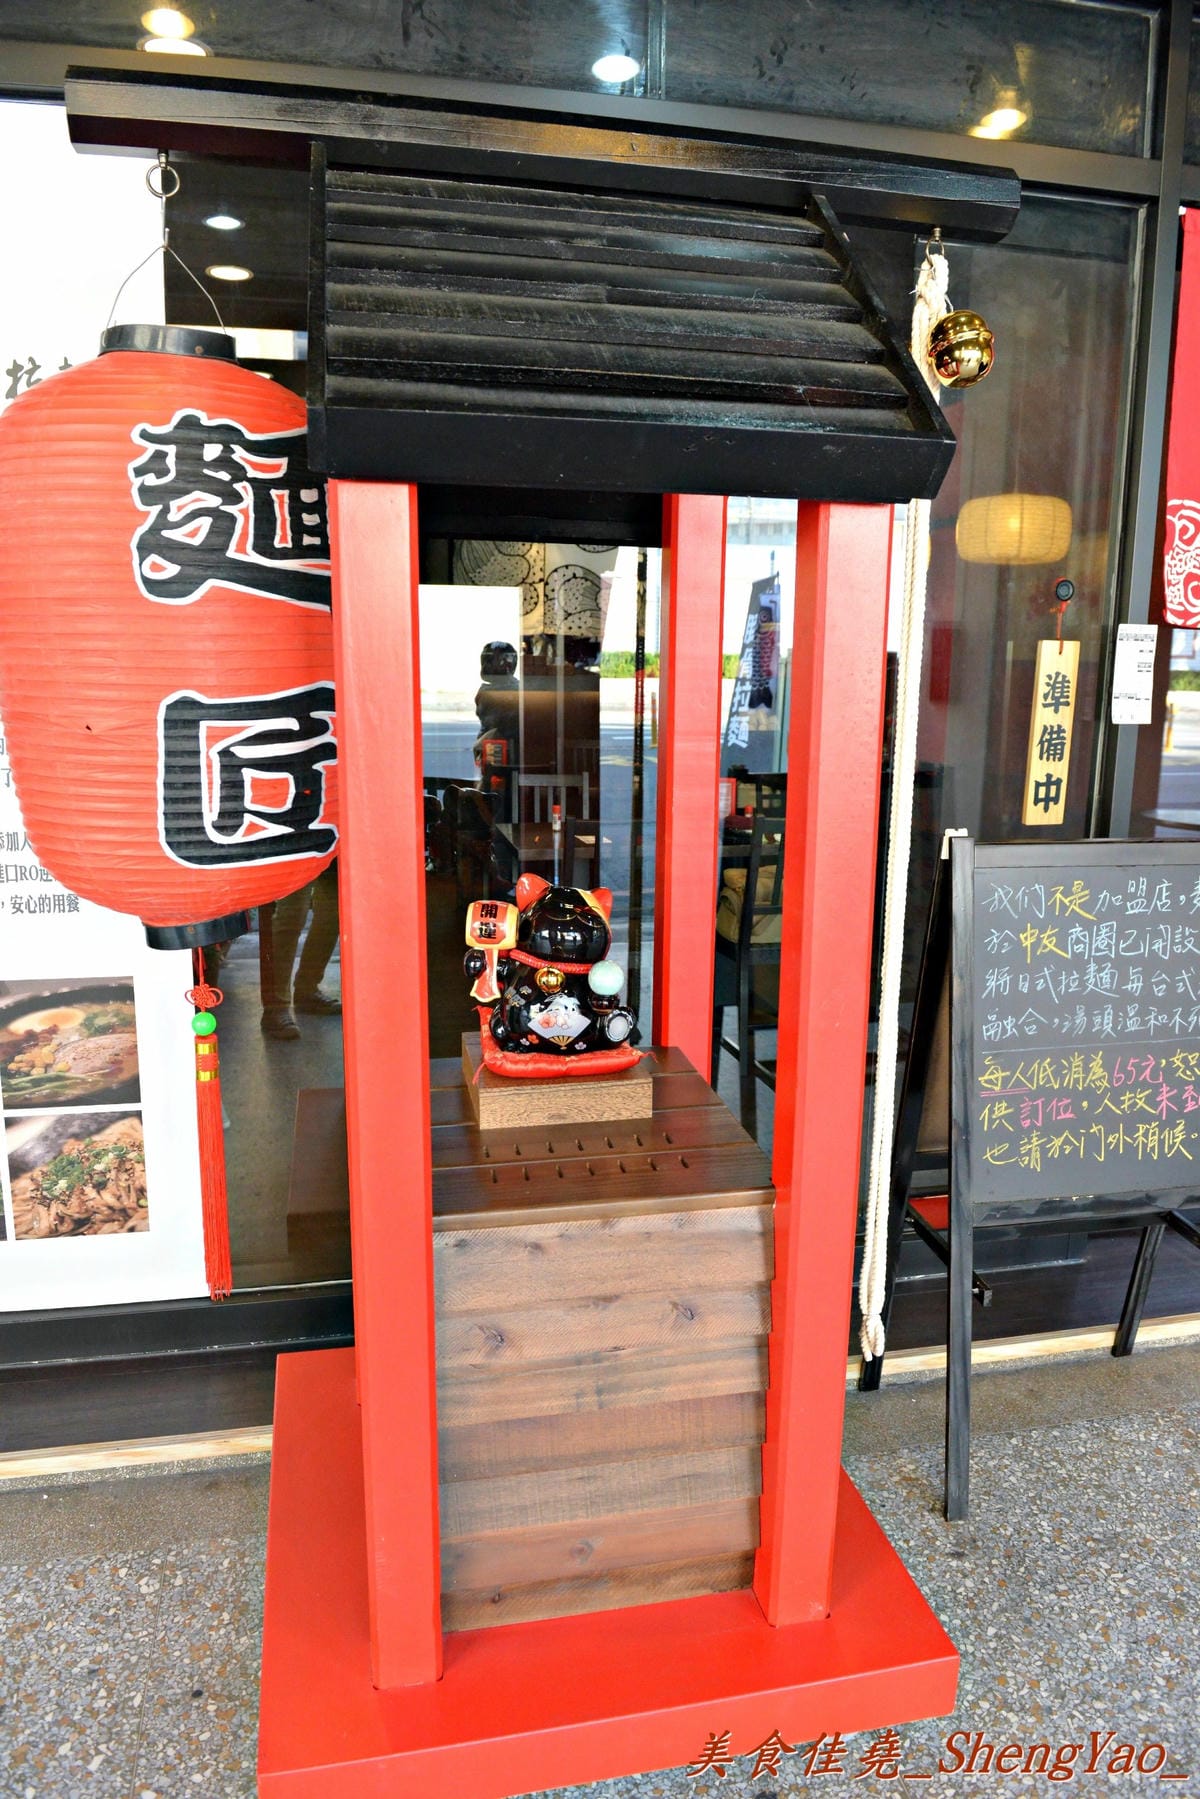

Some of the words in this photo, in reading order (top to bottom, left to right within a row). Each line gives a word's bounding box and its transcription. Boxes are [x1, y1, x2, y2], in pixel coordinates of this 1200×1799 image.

[1032, 670, 1072, 814] 準備中
[478, 903, 499, 940] 開運
